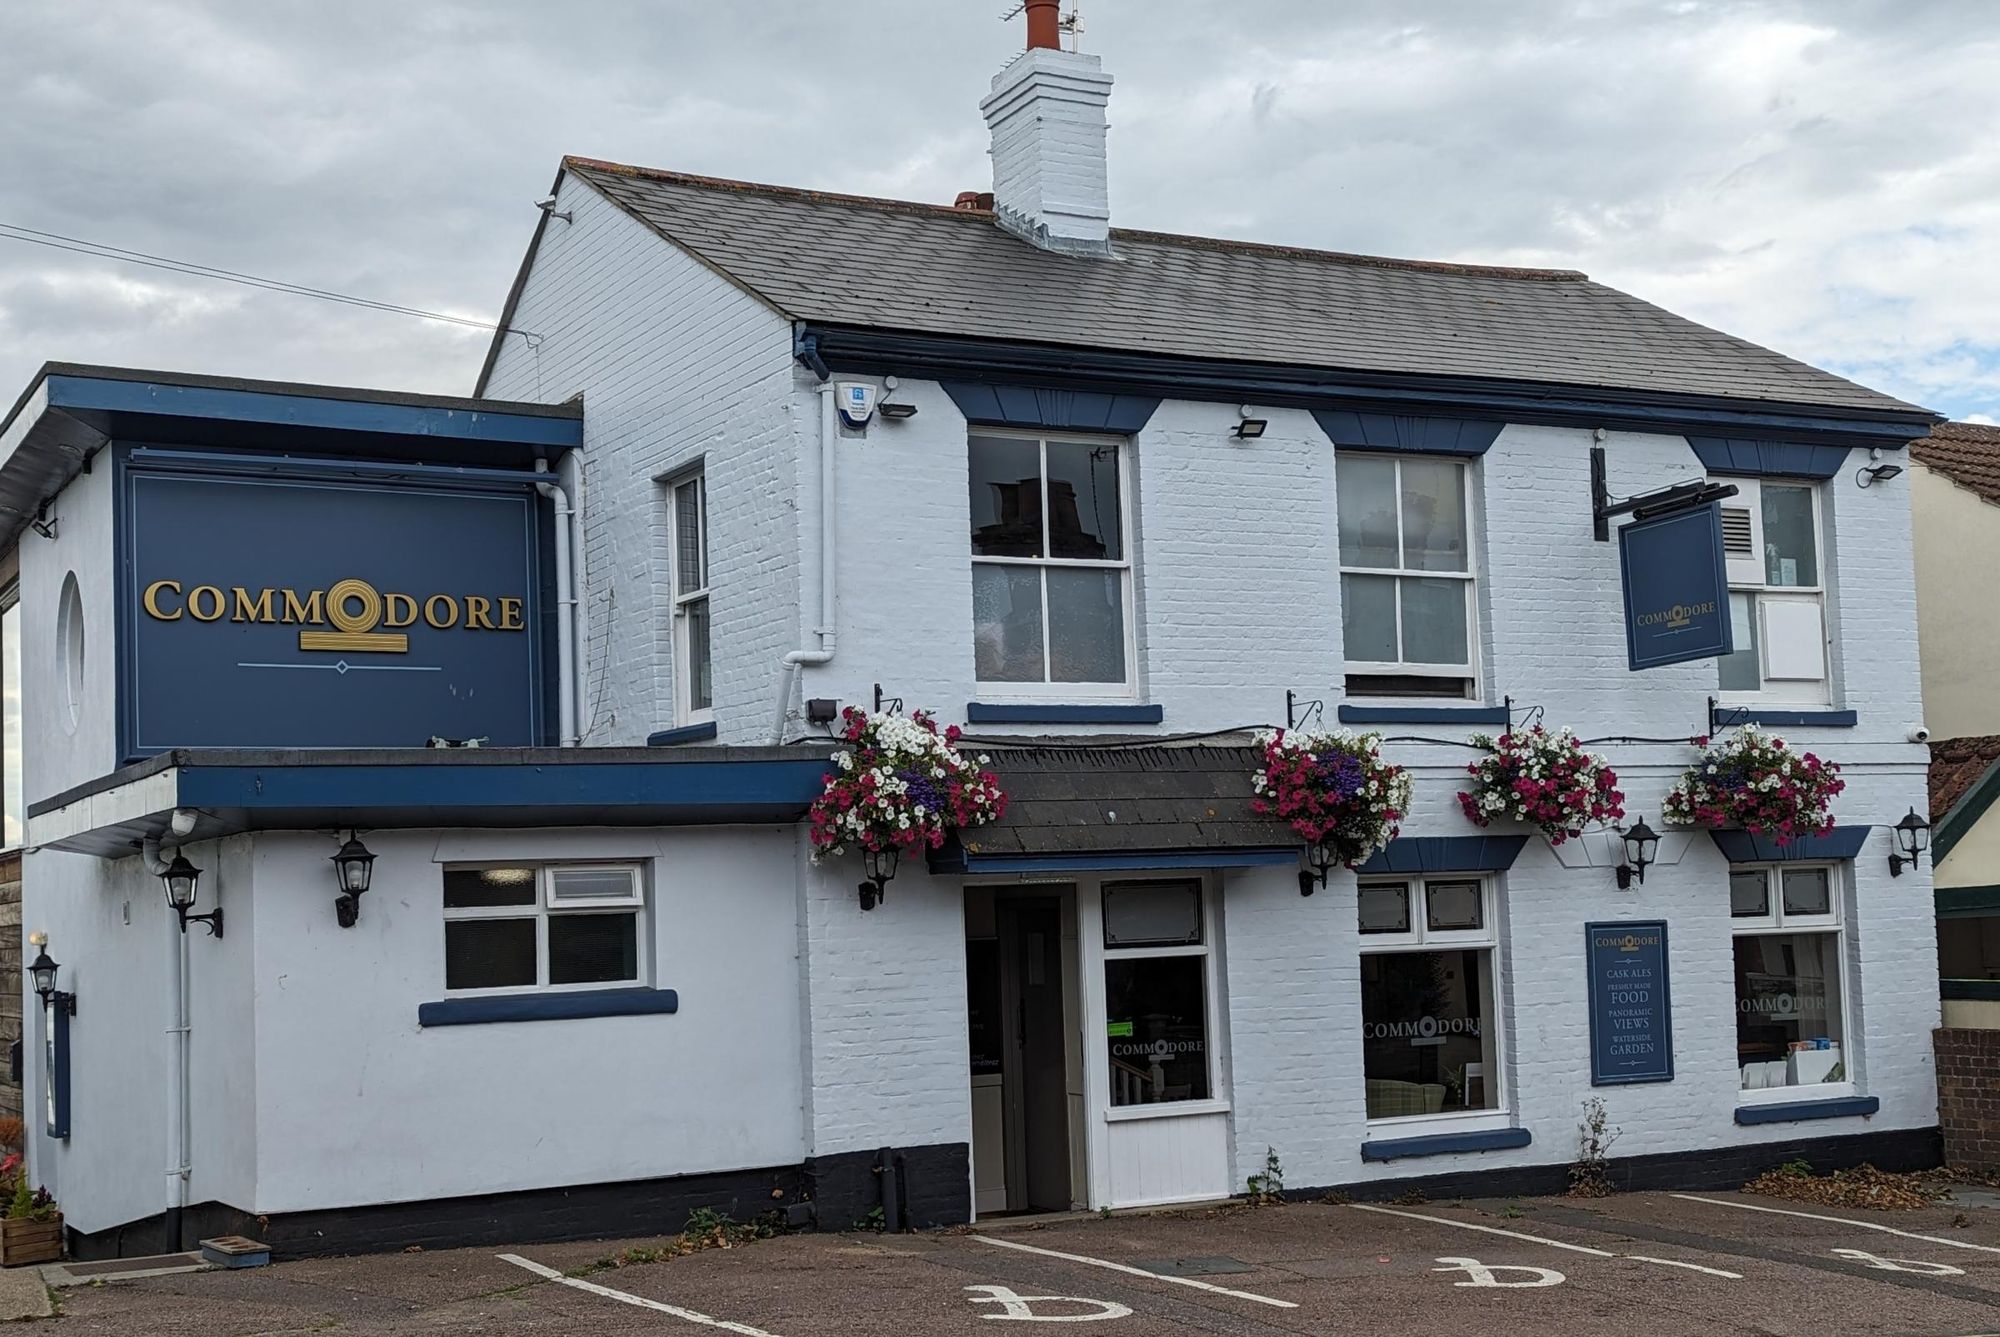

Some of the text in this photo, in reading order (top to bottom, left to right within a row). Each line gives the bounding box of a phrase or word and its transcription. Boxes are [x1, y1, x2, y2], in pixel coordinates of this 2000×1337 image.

[143, 578, 525, 633] COMMODORE
[1637, 602, 1715, 626] COMMODORE
[1595, 935, 1659, 948] COMMODORE
[1607, 968, 1652, 978] CASK ALES
[1612, 991, 1649, 1003] FOOD
[1608, 1008, 1653, 1017] PANORAMIC
[1614, 1018, 1649, 1029] VIEWS
[1113, 1040, 1204, 1055] COMMODORE
[1610, 1043, 1654, 1055] GARDEN
